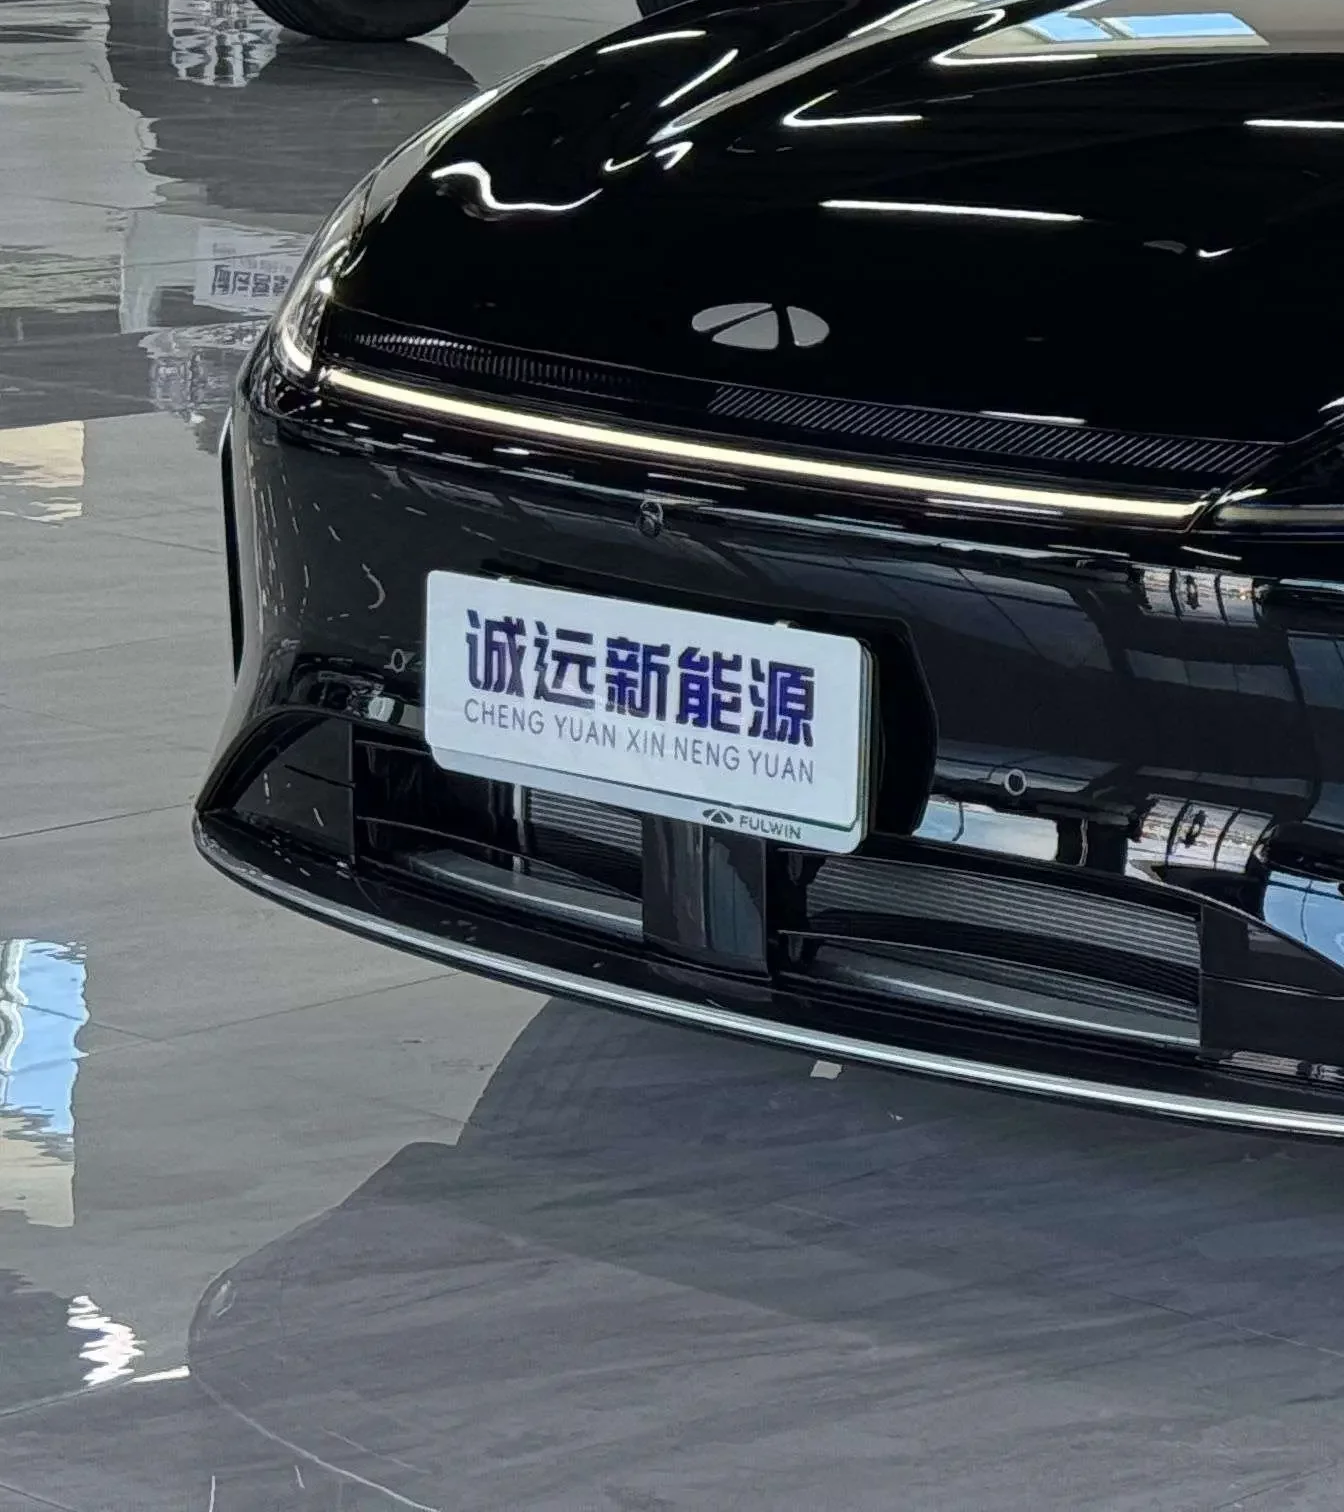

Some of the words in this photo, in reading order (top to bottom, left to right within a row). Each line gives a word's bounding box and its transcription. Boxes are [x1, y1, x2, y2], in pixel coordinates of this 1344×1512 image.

[466, 609, 815, 747] 诚远新能源
[464, 698, 545, 735] CHENG
[554, 714, 617, 749] YUAN
[626, 726, 665, 758] XIN
[674, 735, 741, 771] NENG
[748, 748, 815, 785] YUAN
[739, 814, 803, 840] FULWIN
